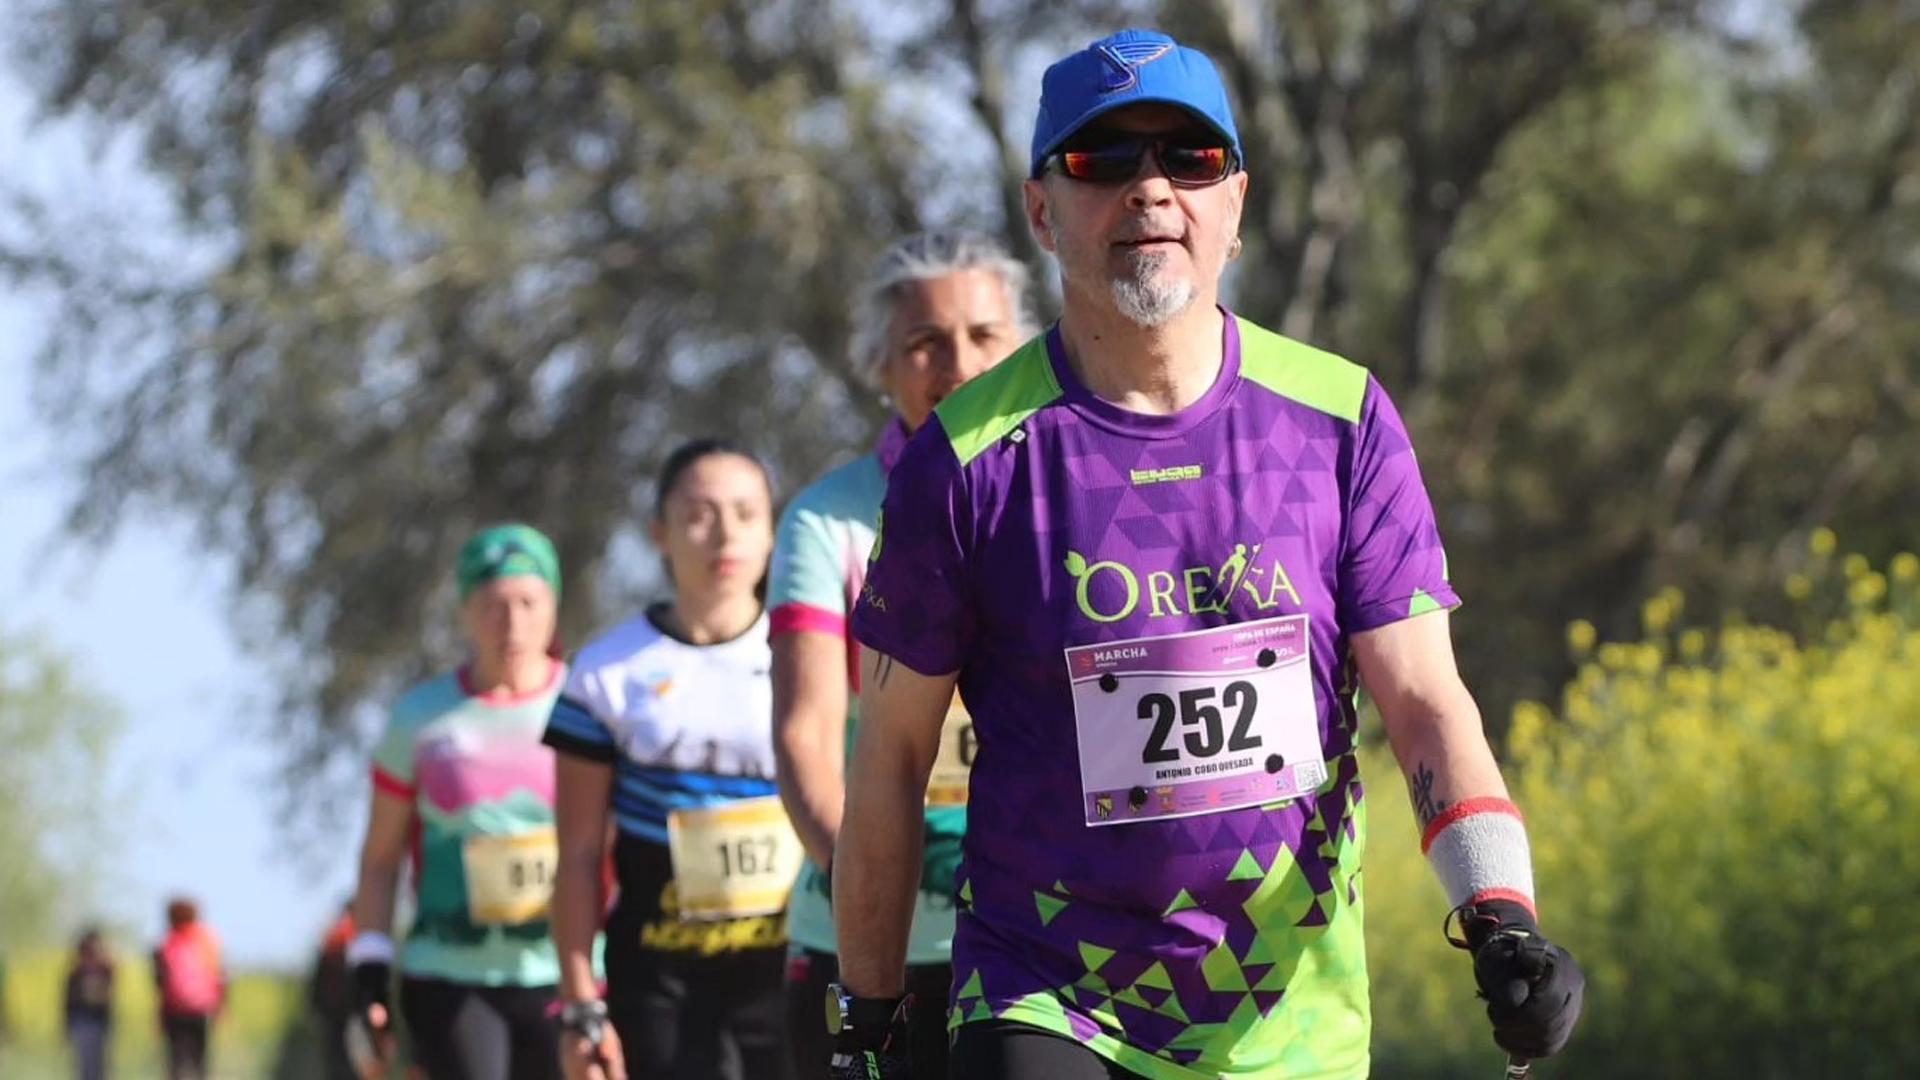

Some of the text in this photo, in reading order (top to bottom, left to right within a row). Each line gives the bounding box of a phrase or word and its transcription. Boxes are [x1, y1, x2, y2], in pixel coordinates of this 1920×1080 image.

[1094, 647, 1149, 662] MARCHA
[1137, 680, 1263, 764] 252
[1156, 757, 1254, 780] ANTONIO COBO QUESADA
[718, 836, 778, 877] 162
